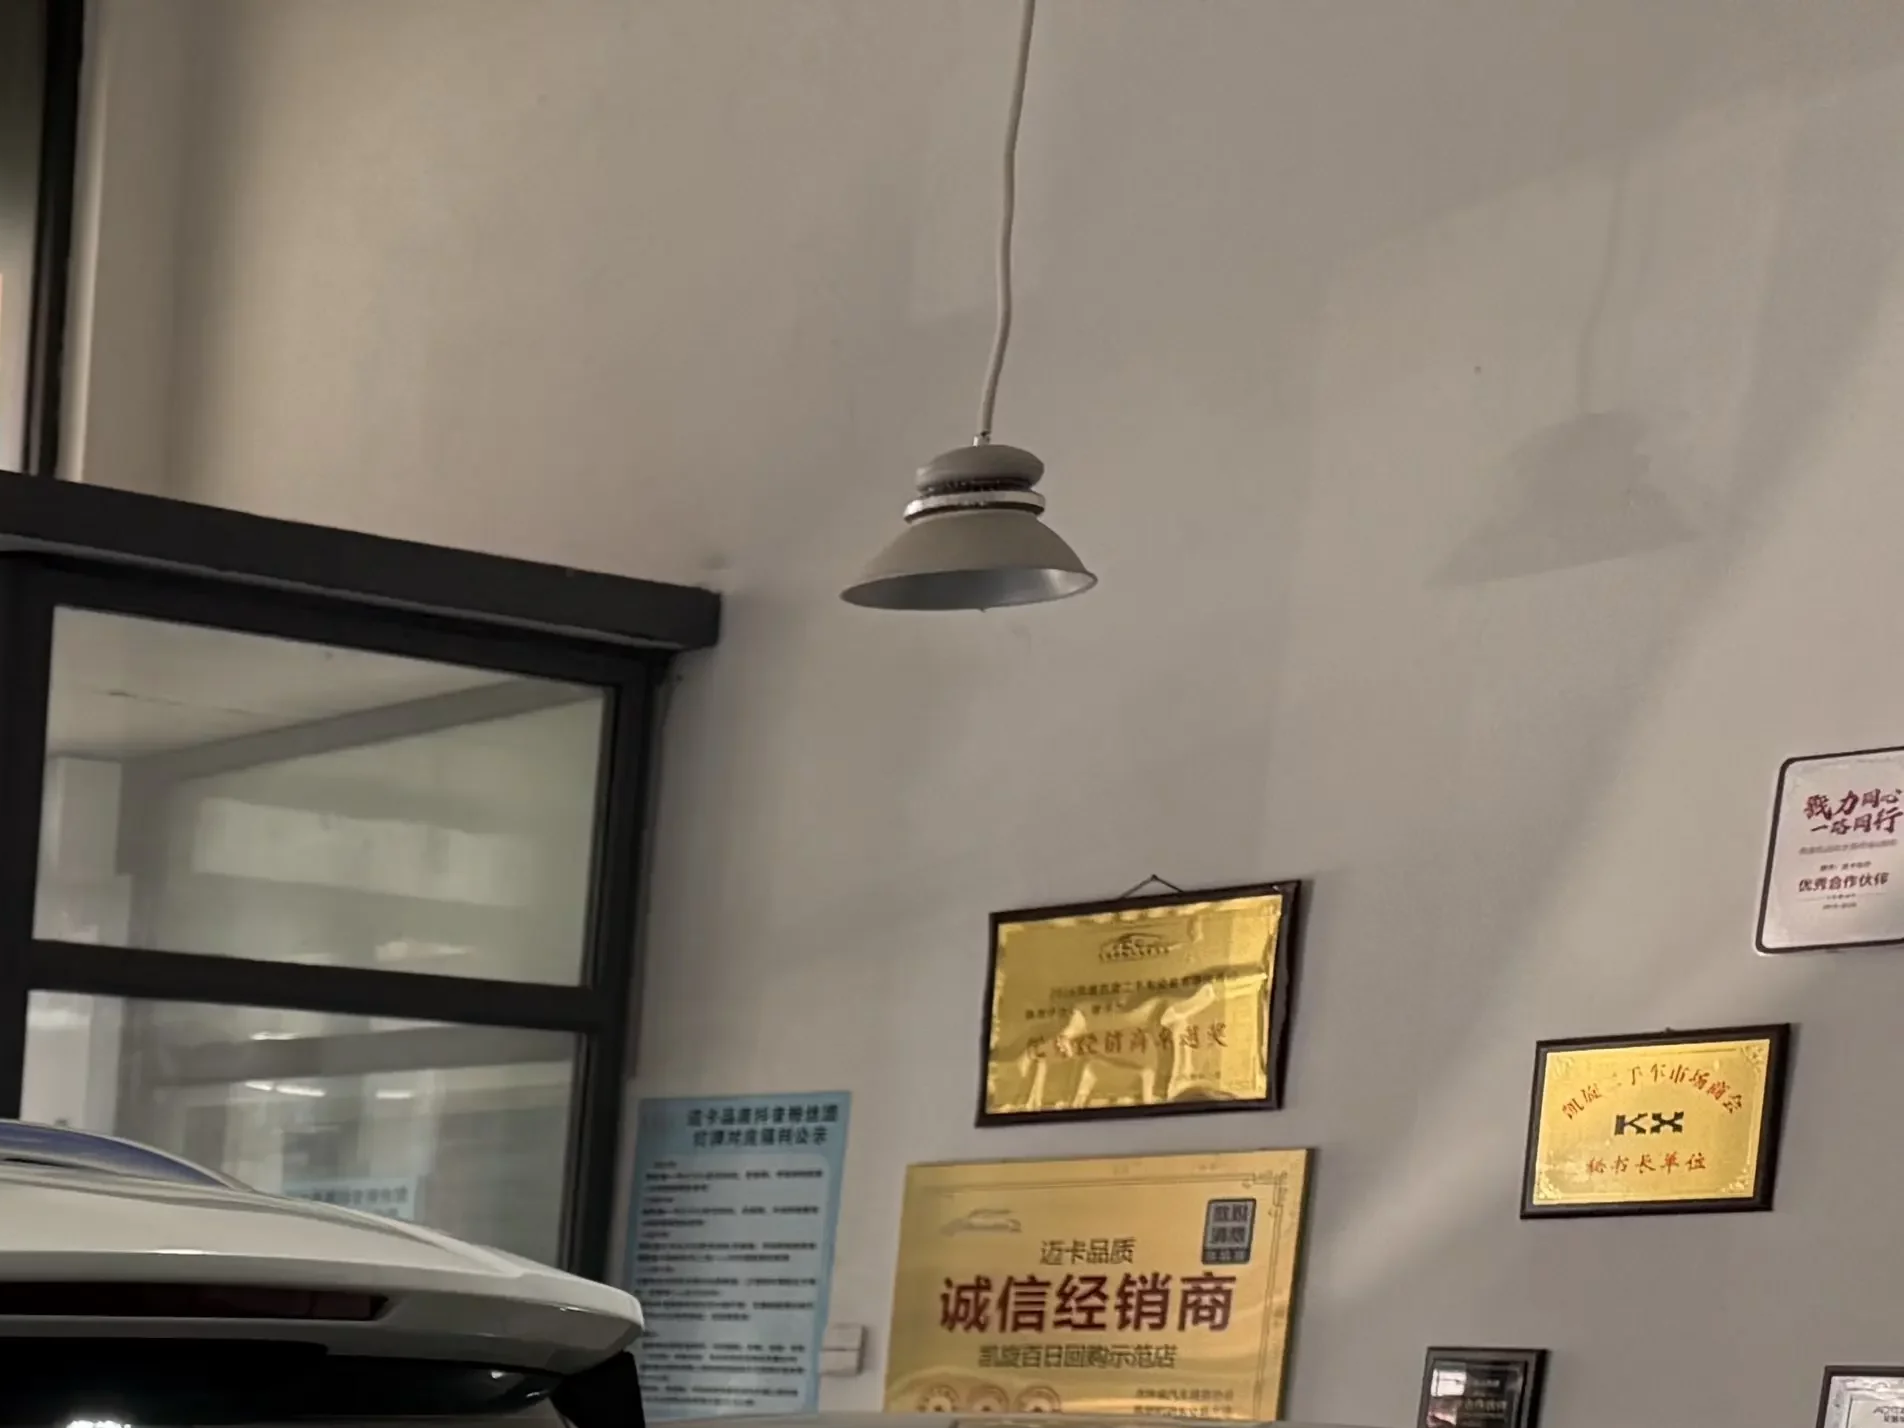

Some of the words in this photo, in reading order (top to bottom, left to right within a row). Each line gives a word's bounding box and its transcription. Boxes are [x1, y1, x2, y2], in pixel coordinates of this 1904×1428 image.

[1810, 807, 1904, 835] 一路同行
[1798, 872, 1891, 893] 优秀合作伙伴
[1614, 1111, 1685, 1136] KX
[1586, 1151, 1707, 1175] 秘书长单位
[1039, 1237, 1136, 1266] 迈卡品质
[939, 1271, 1237, 1334] 诚信经销商
[978, 1344, 1179, 1370] 凯旋百日回购示范店
